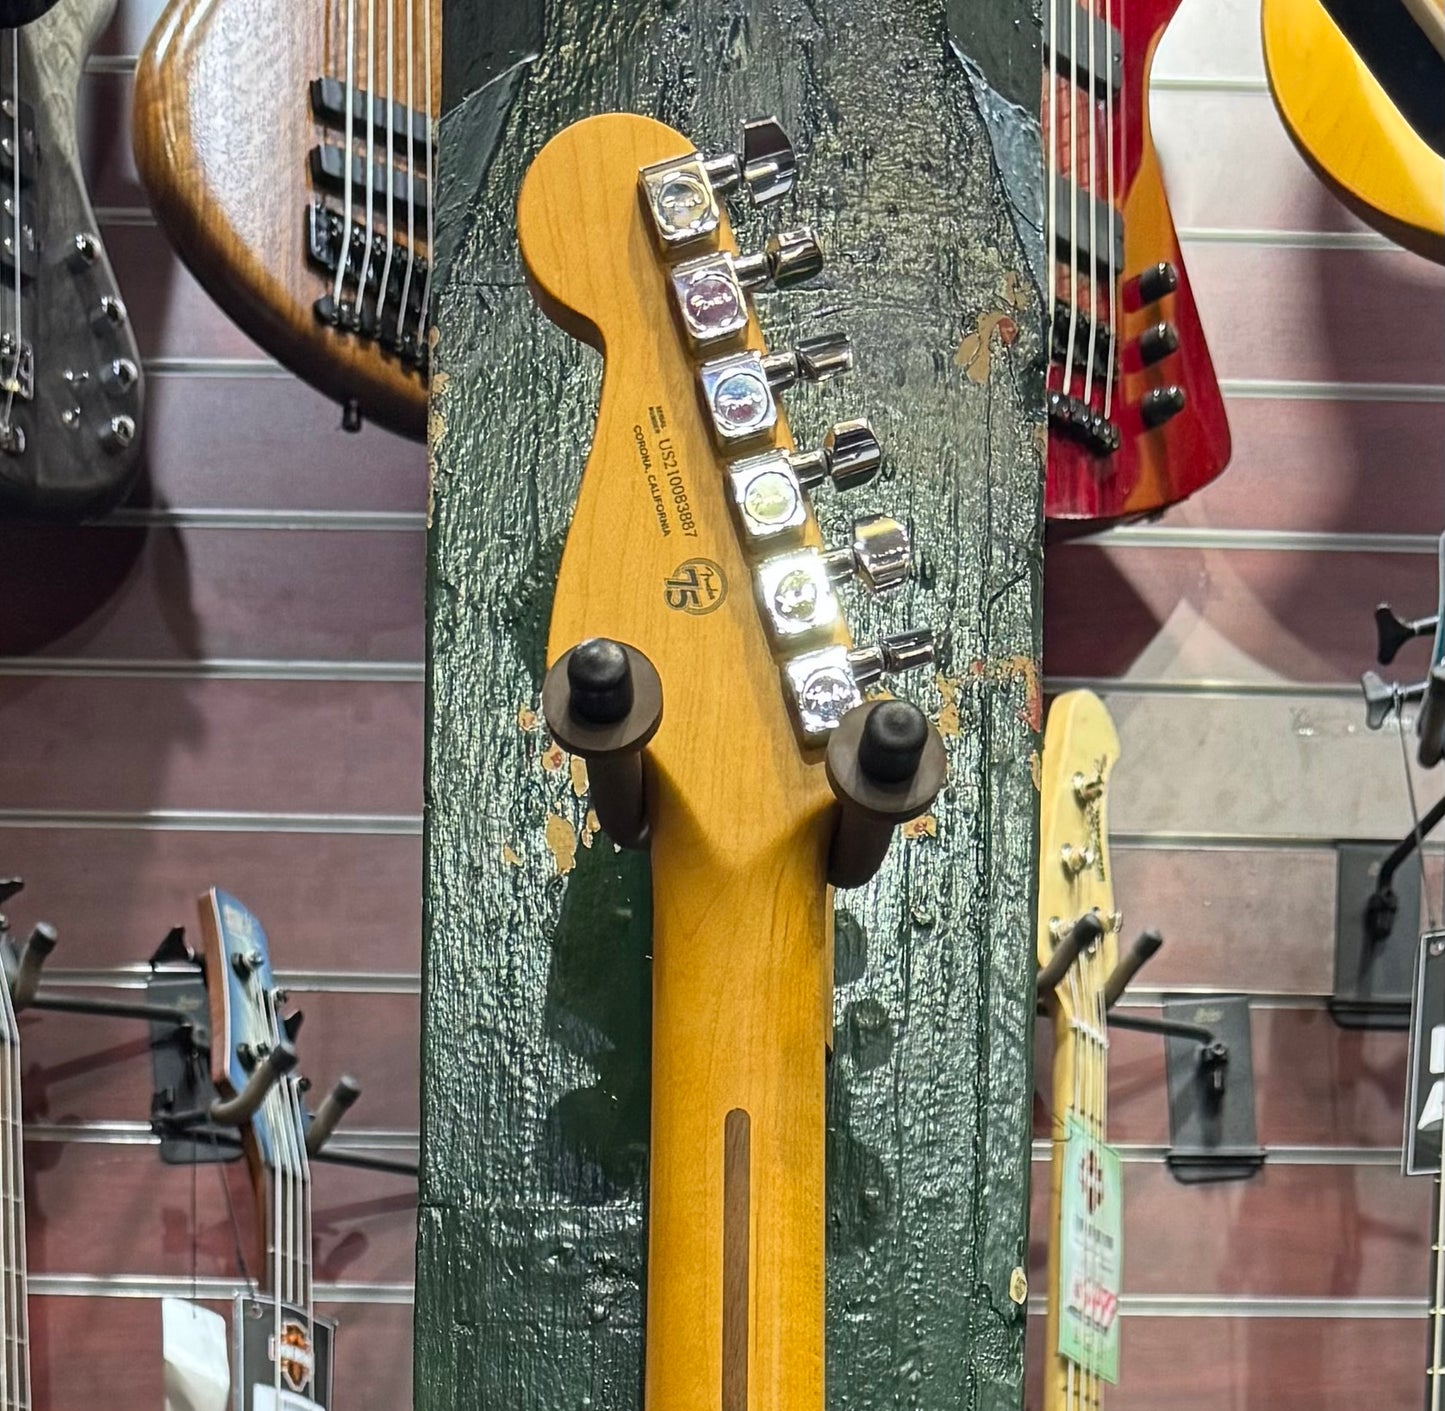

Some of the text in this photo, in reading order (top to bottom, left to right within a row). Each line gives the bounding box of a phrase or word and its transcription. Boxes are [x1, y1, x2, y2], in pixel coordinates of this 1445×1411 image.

[633, 425, 672, 537] CORONA, CALIFORNIA
[658, 438, 698, 538] US210083887
[664, 566, 703, 611] 75
